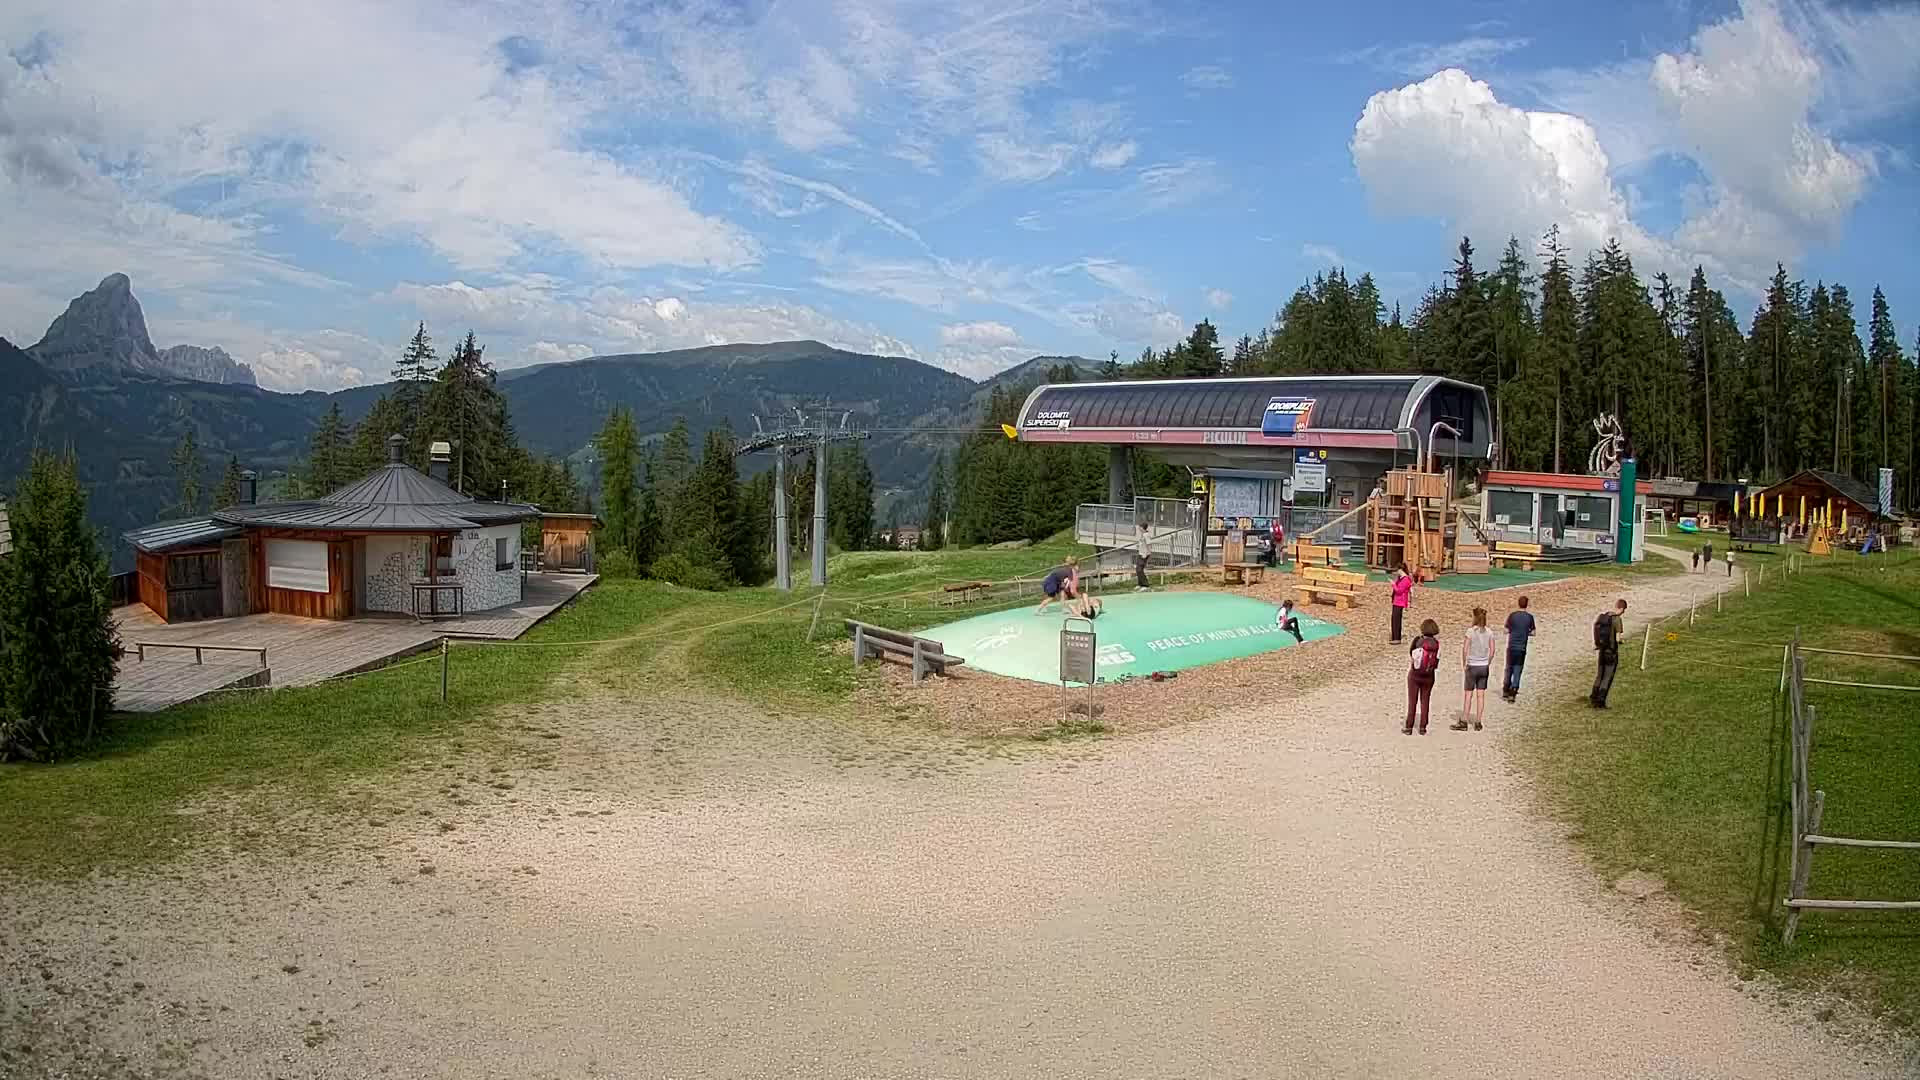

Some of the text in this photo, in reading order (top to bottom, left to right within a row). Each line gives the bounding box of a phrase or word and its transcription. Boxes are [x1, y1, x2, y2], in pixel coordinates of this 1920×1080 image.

[1037, 411, 1069, 419] DOLOMITI
[1026, 419, 1059, 427] SUPERSKI
[1203, 431, 1247, 444] PICULIN
[1146, 635, 1190, 652] PEACE
[1189, 631, 1206, 643] OF
[1206, 630, 1236, 641] MIND
